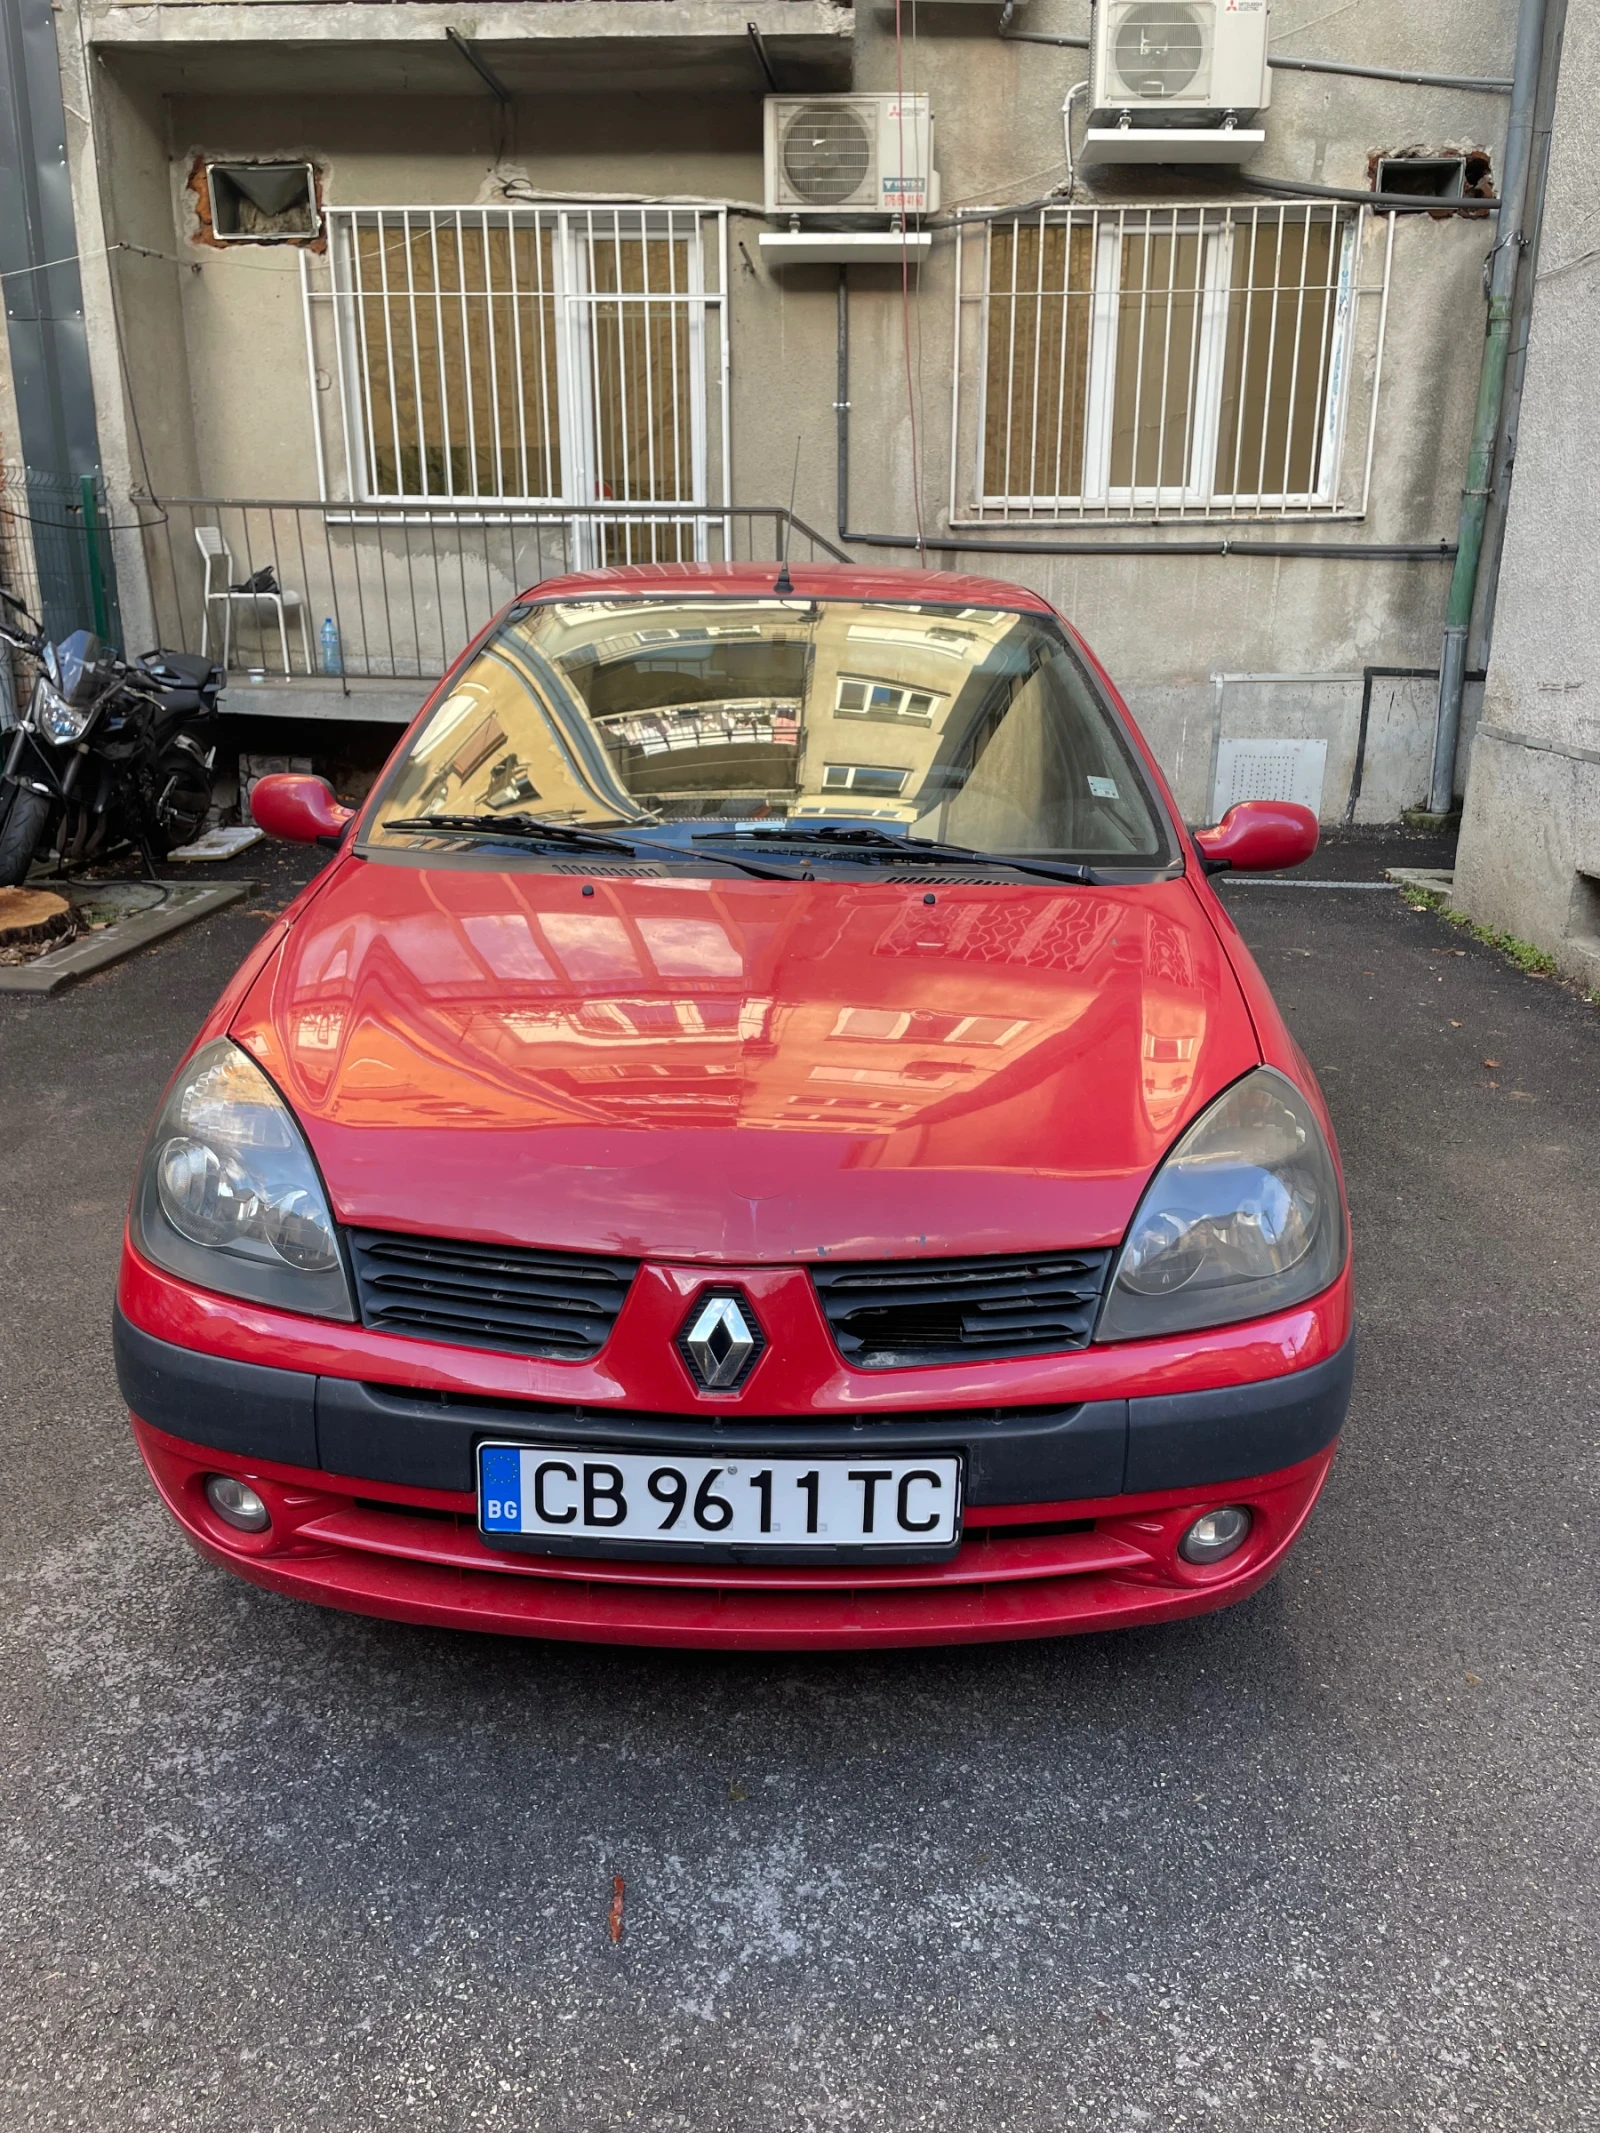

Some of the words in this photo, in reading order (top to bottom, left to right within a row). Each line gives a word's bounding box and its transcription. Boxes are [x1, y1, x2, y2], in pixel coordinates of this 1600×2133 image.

[488, 1500, 518, 1519] BG
[534, 1460, 628, 1527] CB
[647, 1466, 820, 1533] 9611
[848, 1470, 942, 1533] TC
